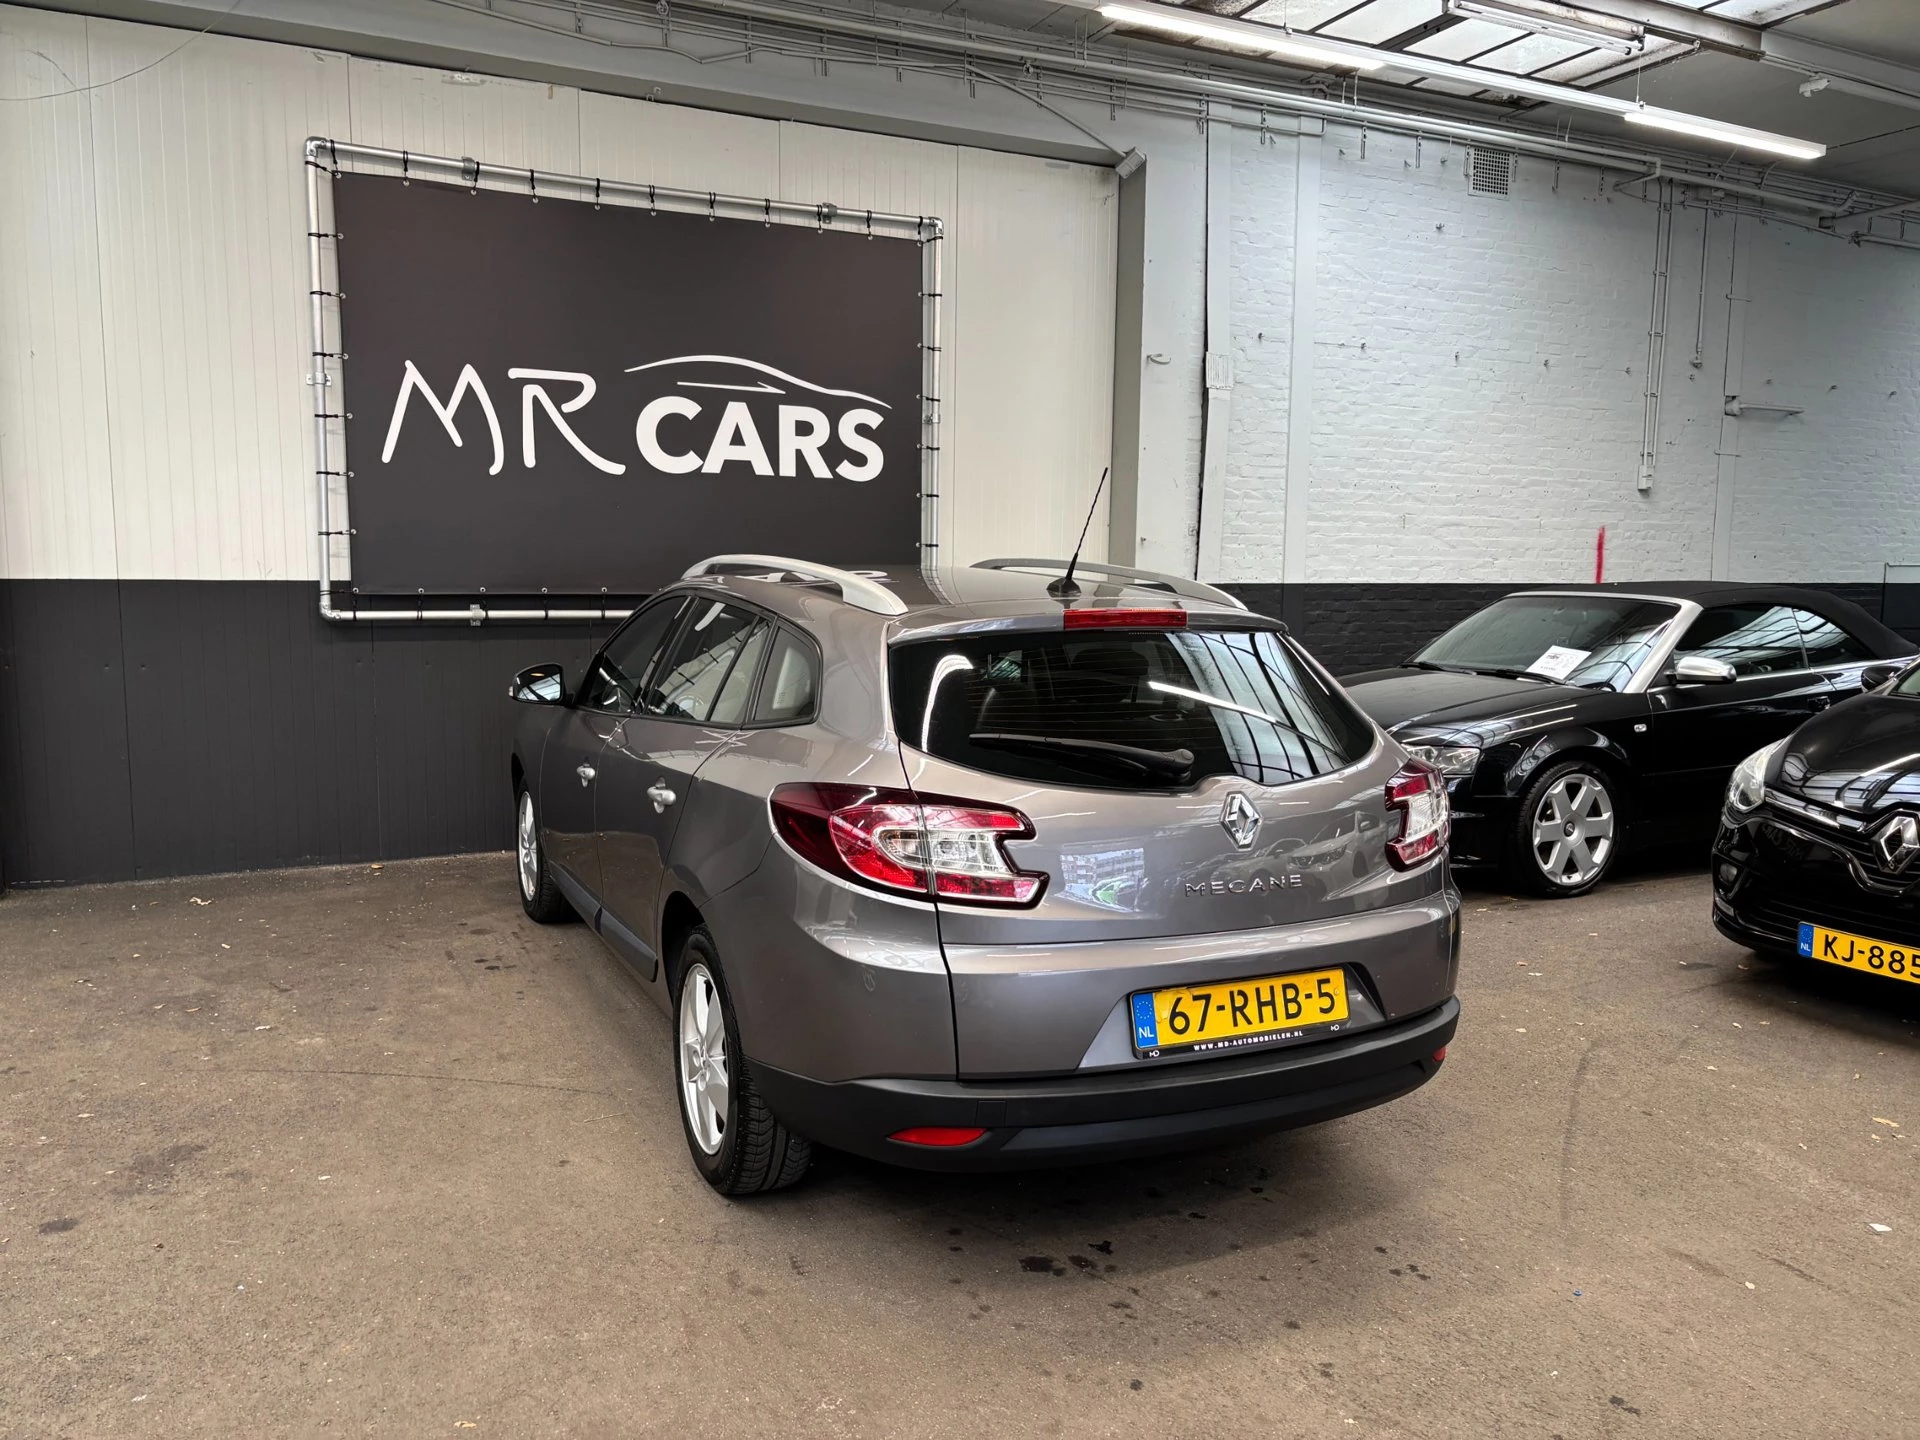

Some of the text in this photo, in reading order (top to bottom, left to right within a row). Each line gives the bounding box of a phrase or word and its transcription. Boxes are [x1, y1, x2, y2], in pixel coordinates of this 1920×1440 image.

[381, 359, 885, 483] MR CARS
[1800, 942, 1811, 952] NL
[1823, 934, 1920, 979] KJ-885
[1168, 978, 1336, 1036] 67-RHB-5
[1138, 1026, 1155, 1039] NL
[1193, 1030, 1304, 1052] WWW.MD-AUTOMOBIELEN.NL
